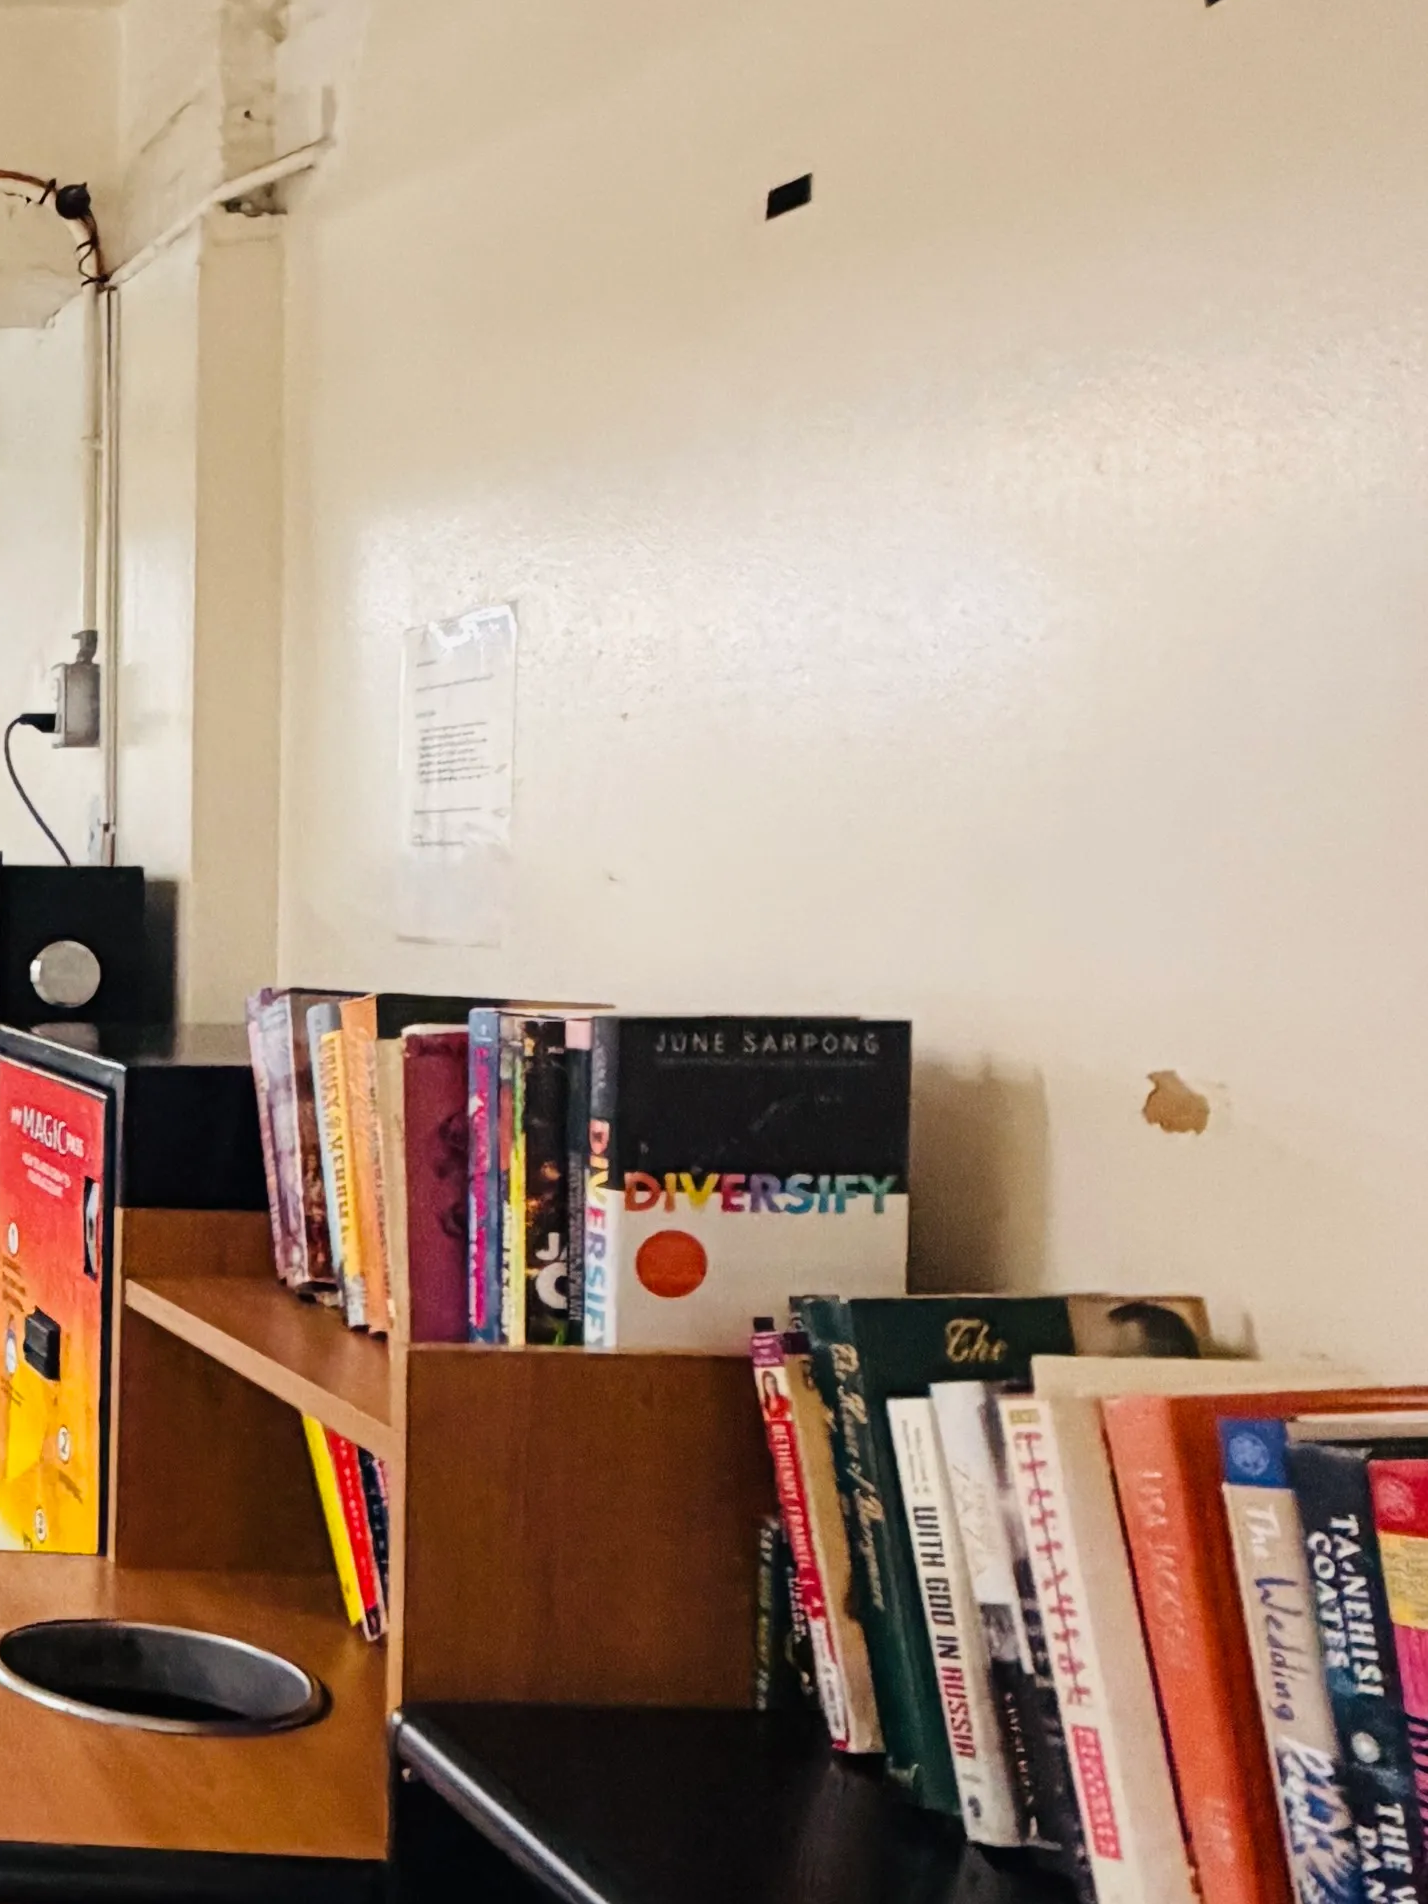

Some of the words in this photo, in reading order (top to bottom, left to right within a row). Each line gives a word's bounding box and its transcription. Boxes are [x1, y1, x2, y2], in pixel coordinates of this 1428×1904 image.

[655, 1031, 726, 1053] JUNE
[742, 1033, 881, 1055] SARPONG
[22, 1105, 69, 1156] MAGIC
[624, 1170, 897, 1214] DIVERSIFY
[945, 1318, 1009, 1364] The
[770, 1424, 800, 1502] BETHENNY
[785, 1503, 815, 1573] FRANKEL
[912, 1505, 947, 1569] WITH
[1244, 1504, 1282, 1559] The
[924, 1576, 956, 1627] GOD
[1307, 1530, 1350, 1668] COATES
[1330, 1513, 1385, 1697] TA-NEHISI
[936, 1634, 963, 1661] IN
[1254, 1576, 1314, 1723] Wedding
[941, 1666, 977, 1760] RUSSIA
[1374, 1802, 1414, 1875] THE
